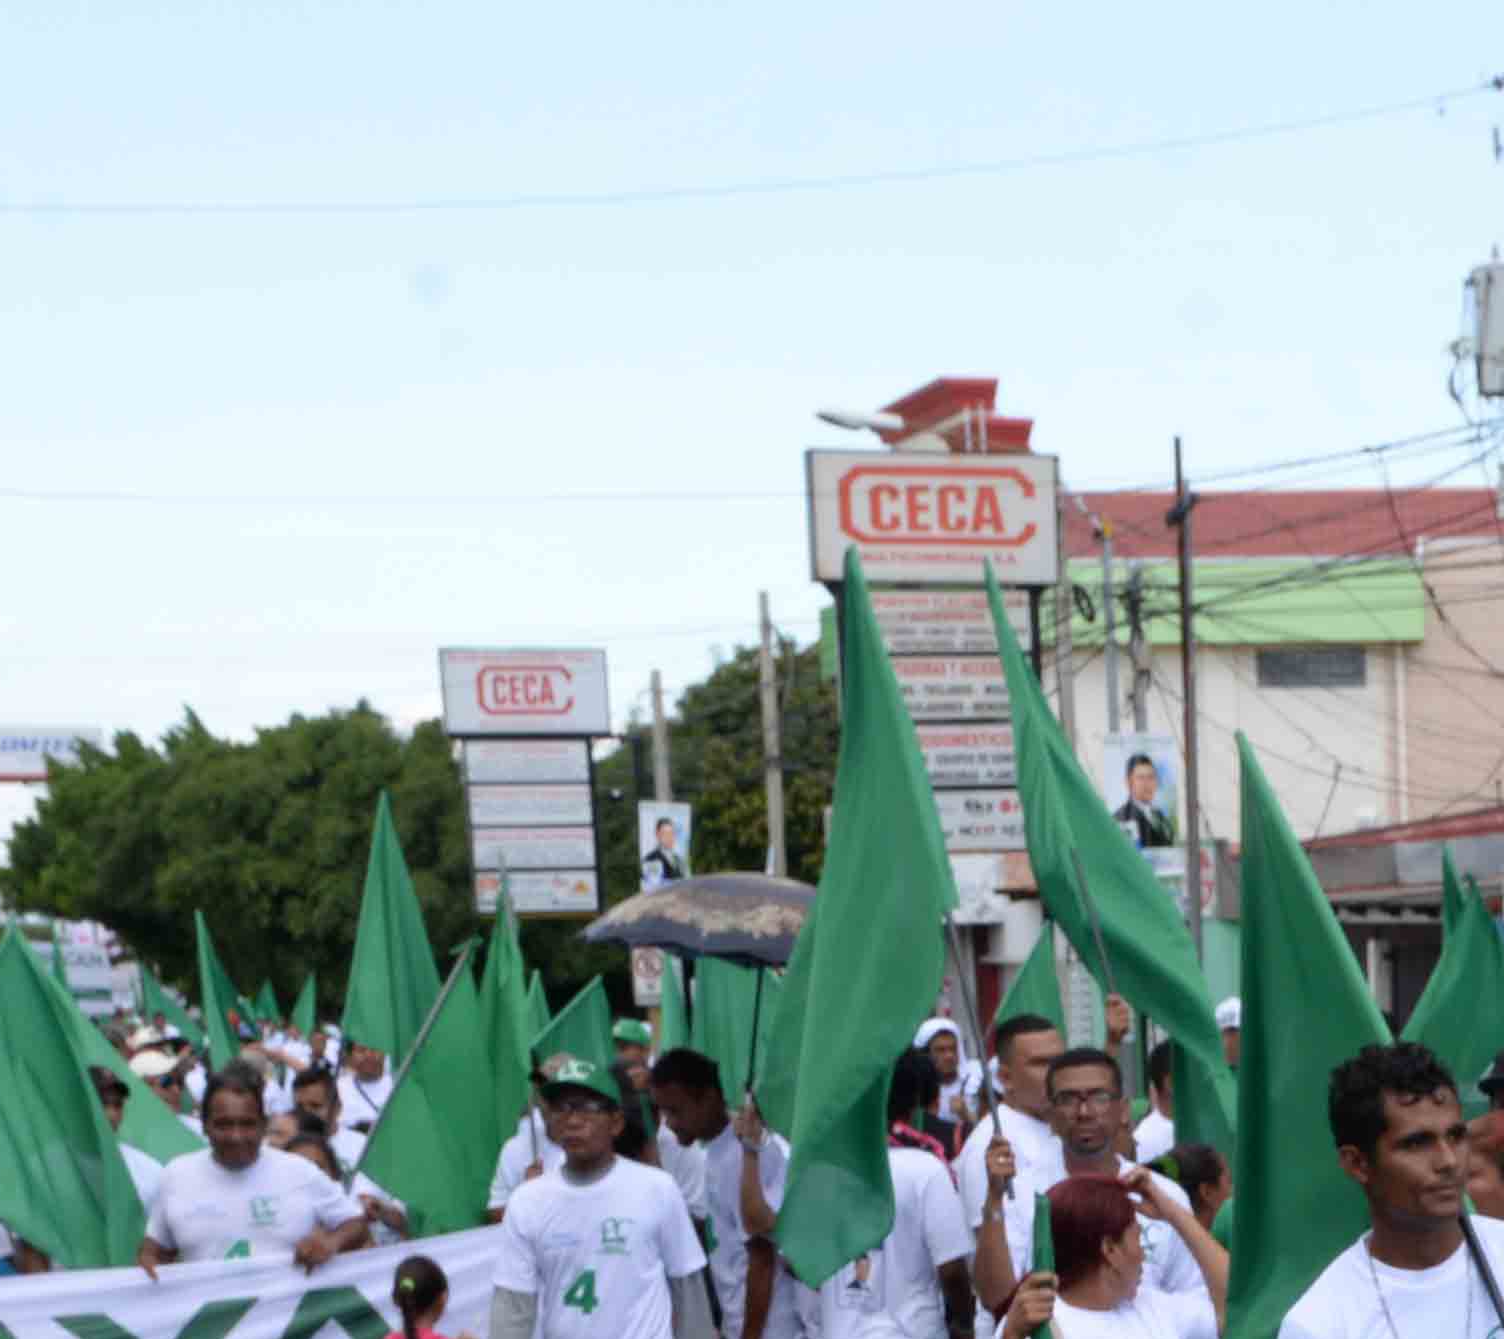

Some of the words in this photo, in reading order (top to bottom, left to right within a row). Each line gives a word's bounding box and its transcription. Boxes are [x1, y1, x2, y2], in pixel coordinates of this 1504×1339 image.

[869, 484, 1004, 532] CECA
[492, 673, 555, 704] CECA
[561, 1268, 600, 1314] 4
